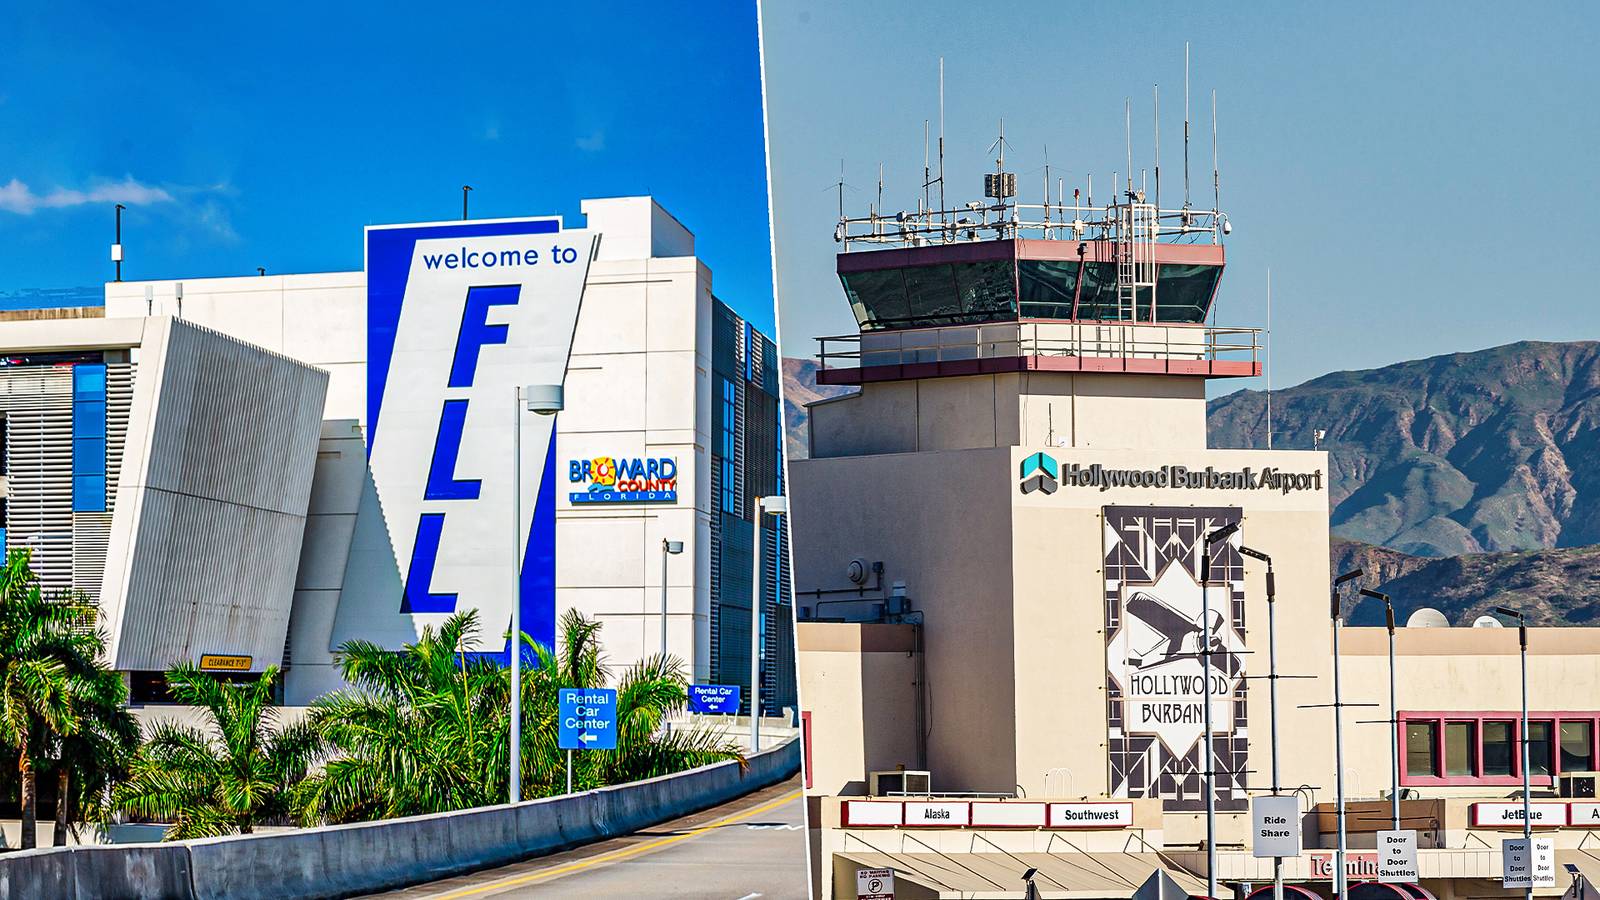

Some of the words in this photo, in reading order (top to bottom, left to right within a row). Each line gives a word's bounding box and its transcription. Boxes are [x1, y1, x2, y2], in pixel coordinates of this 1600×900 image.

[423, 246, 538, 270] welcome
[551, 244, 578, 265] to
[399, 284, 522, 614] FLL
[1062, 463, 1170, 491] Hollywood
[1171, 465, 1257, 490] Burbank
[1259, 466, 1323, 495] Airport
[618, 479, 677, 492] COUNTY
[573, 492, 673, 501] FLORIDA
[208, 658, 235, 667] CLEARANCE
[695, 687, 718, 695] Rental
[719, 687, 733, 695] Car
[566, 692, 609, 705] Rental
[701, 695, 726, 703] Center
[575, 705, 600, 717] Car
[1142, 704, 1213, 724] BURBAN
[565, 717, 610, 730] Center
[924, 808, 951, 820] Alaska
[1065, 808, 1119, 821] Southwest
[1502, 810, 1542, 820] JetBue
[1264, 815, 1287, 825] Ride
[1261, 828, 1290, 838] Share
[1387, 836, 1407, 844] Door
[1392, 847, 1402, 855] to
[1387, 858, 1408, 866] Door
[1379, 869, 1416, 877] Shuttles
